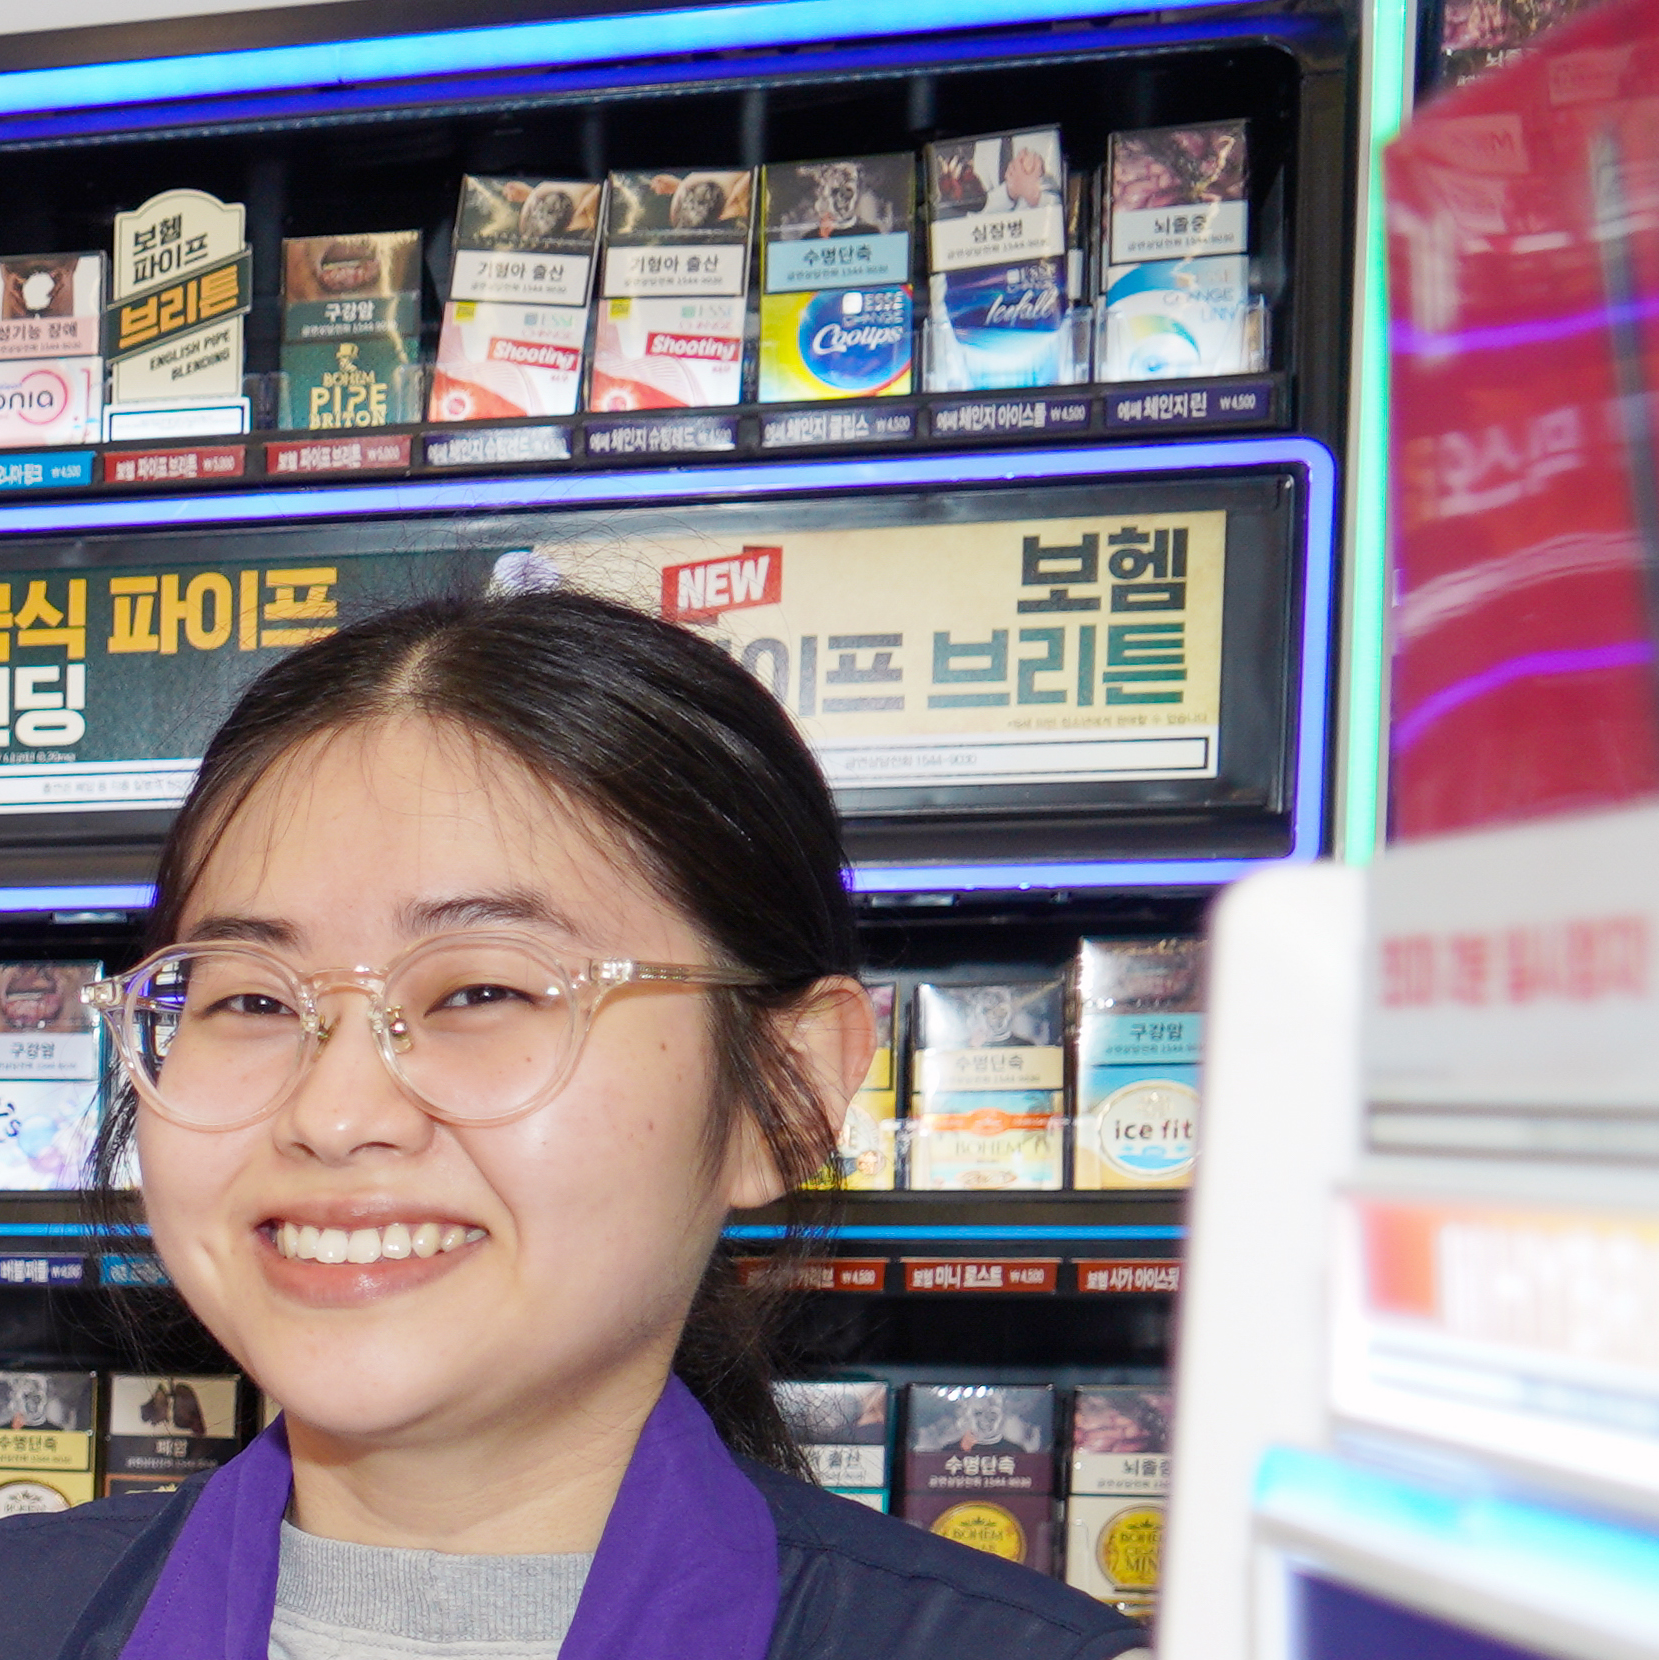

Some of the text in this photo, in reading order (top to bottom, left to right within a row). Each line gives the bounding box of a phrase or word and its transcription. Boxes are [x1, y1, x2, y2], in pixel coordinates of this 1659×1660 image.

[133, 212, 182, 257] 보헴
[970, 219, 1025, 243] 심장병
[132, 232, 209, 286] 파이프
[477, 260, 565, 282] 기형아 출산
[631, 254, 720, 274] 기형아 출산
[802, 244, 873, 267] 수명단축
[118, 264, 240, 350] 브리튼
[324, 302, 376, 323] 구강암
[149, 328, 232, 372] ENGLISH PIPE
[492, 340, 575, 371] Shooting
[651, 334, 736, 361] Shooting
[170, 349, 231, 382] BLENDING
[309, 383, 389, 415] PIPE
[1143, 394, 1189, 420] 체인지
[675, 556, 772, 611] NEW
[1016, 525, 1191, 617] 보헴
[106, 565, 340, 656] 파이프
[721, 620, 1188, 720] 이프 브리튼
[1129, 1022, 1184, 1042] 구강암
[1114, 1117, 1194, 1141] ice fit
[944, 1455, 1016, 1477] 수명단축
